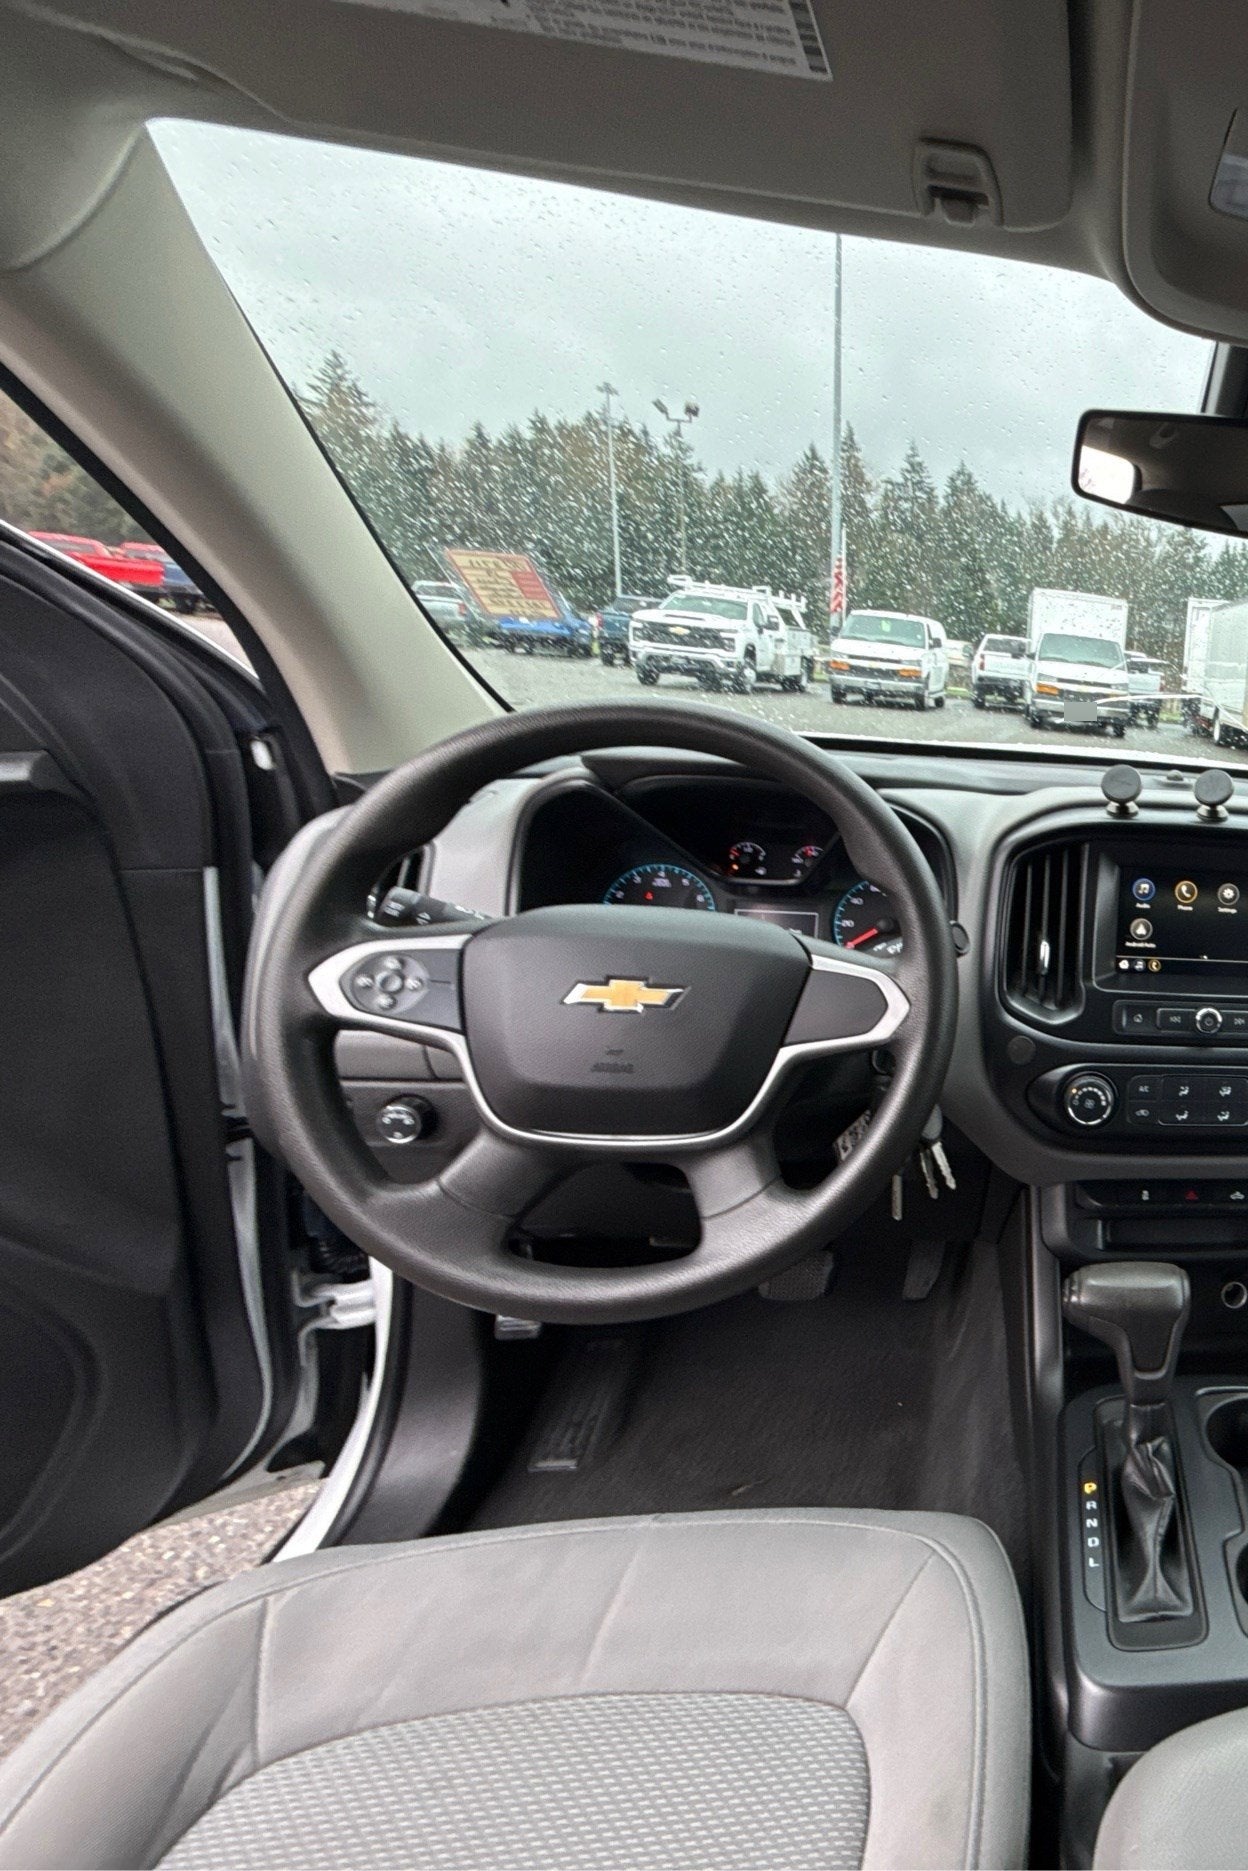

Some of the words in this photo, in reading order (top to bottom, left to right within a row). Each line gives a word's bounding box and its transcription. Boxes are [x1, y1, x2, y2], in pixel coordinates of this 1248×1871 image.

[1084, 1482, 1098, 1494] P
[1085, 1500, 1098, 1510] R
[1086, 1518, 1099, 1528] N
[1087, 1537, 1100, 1548] D
[1088, 1557, 1100, 1568] L
